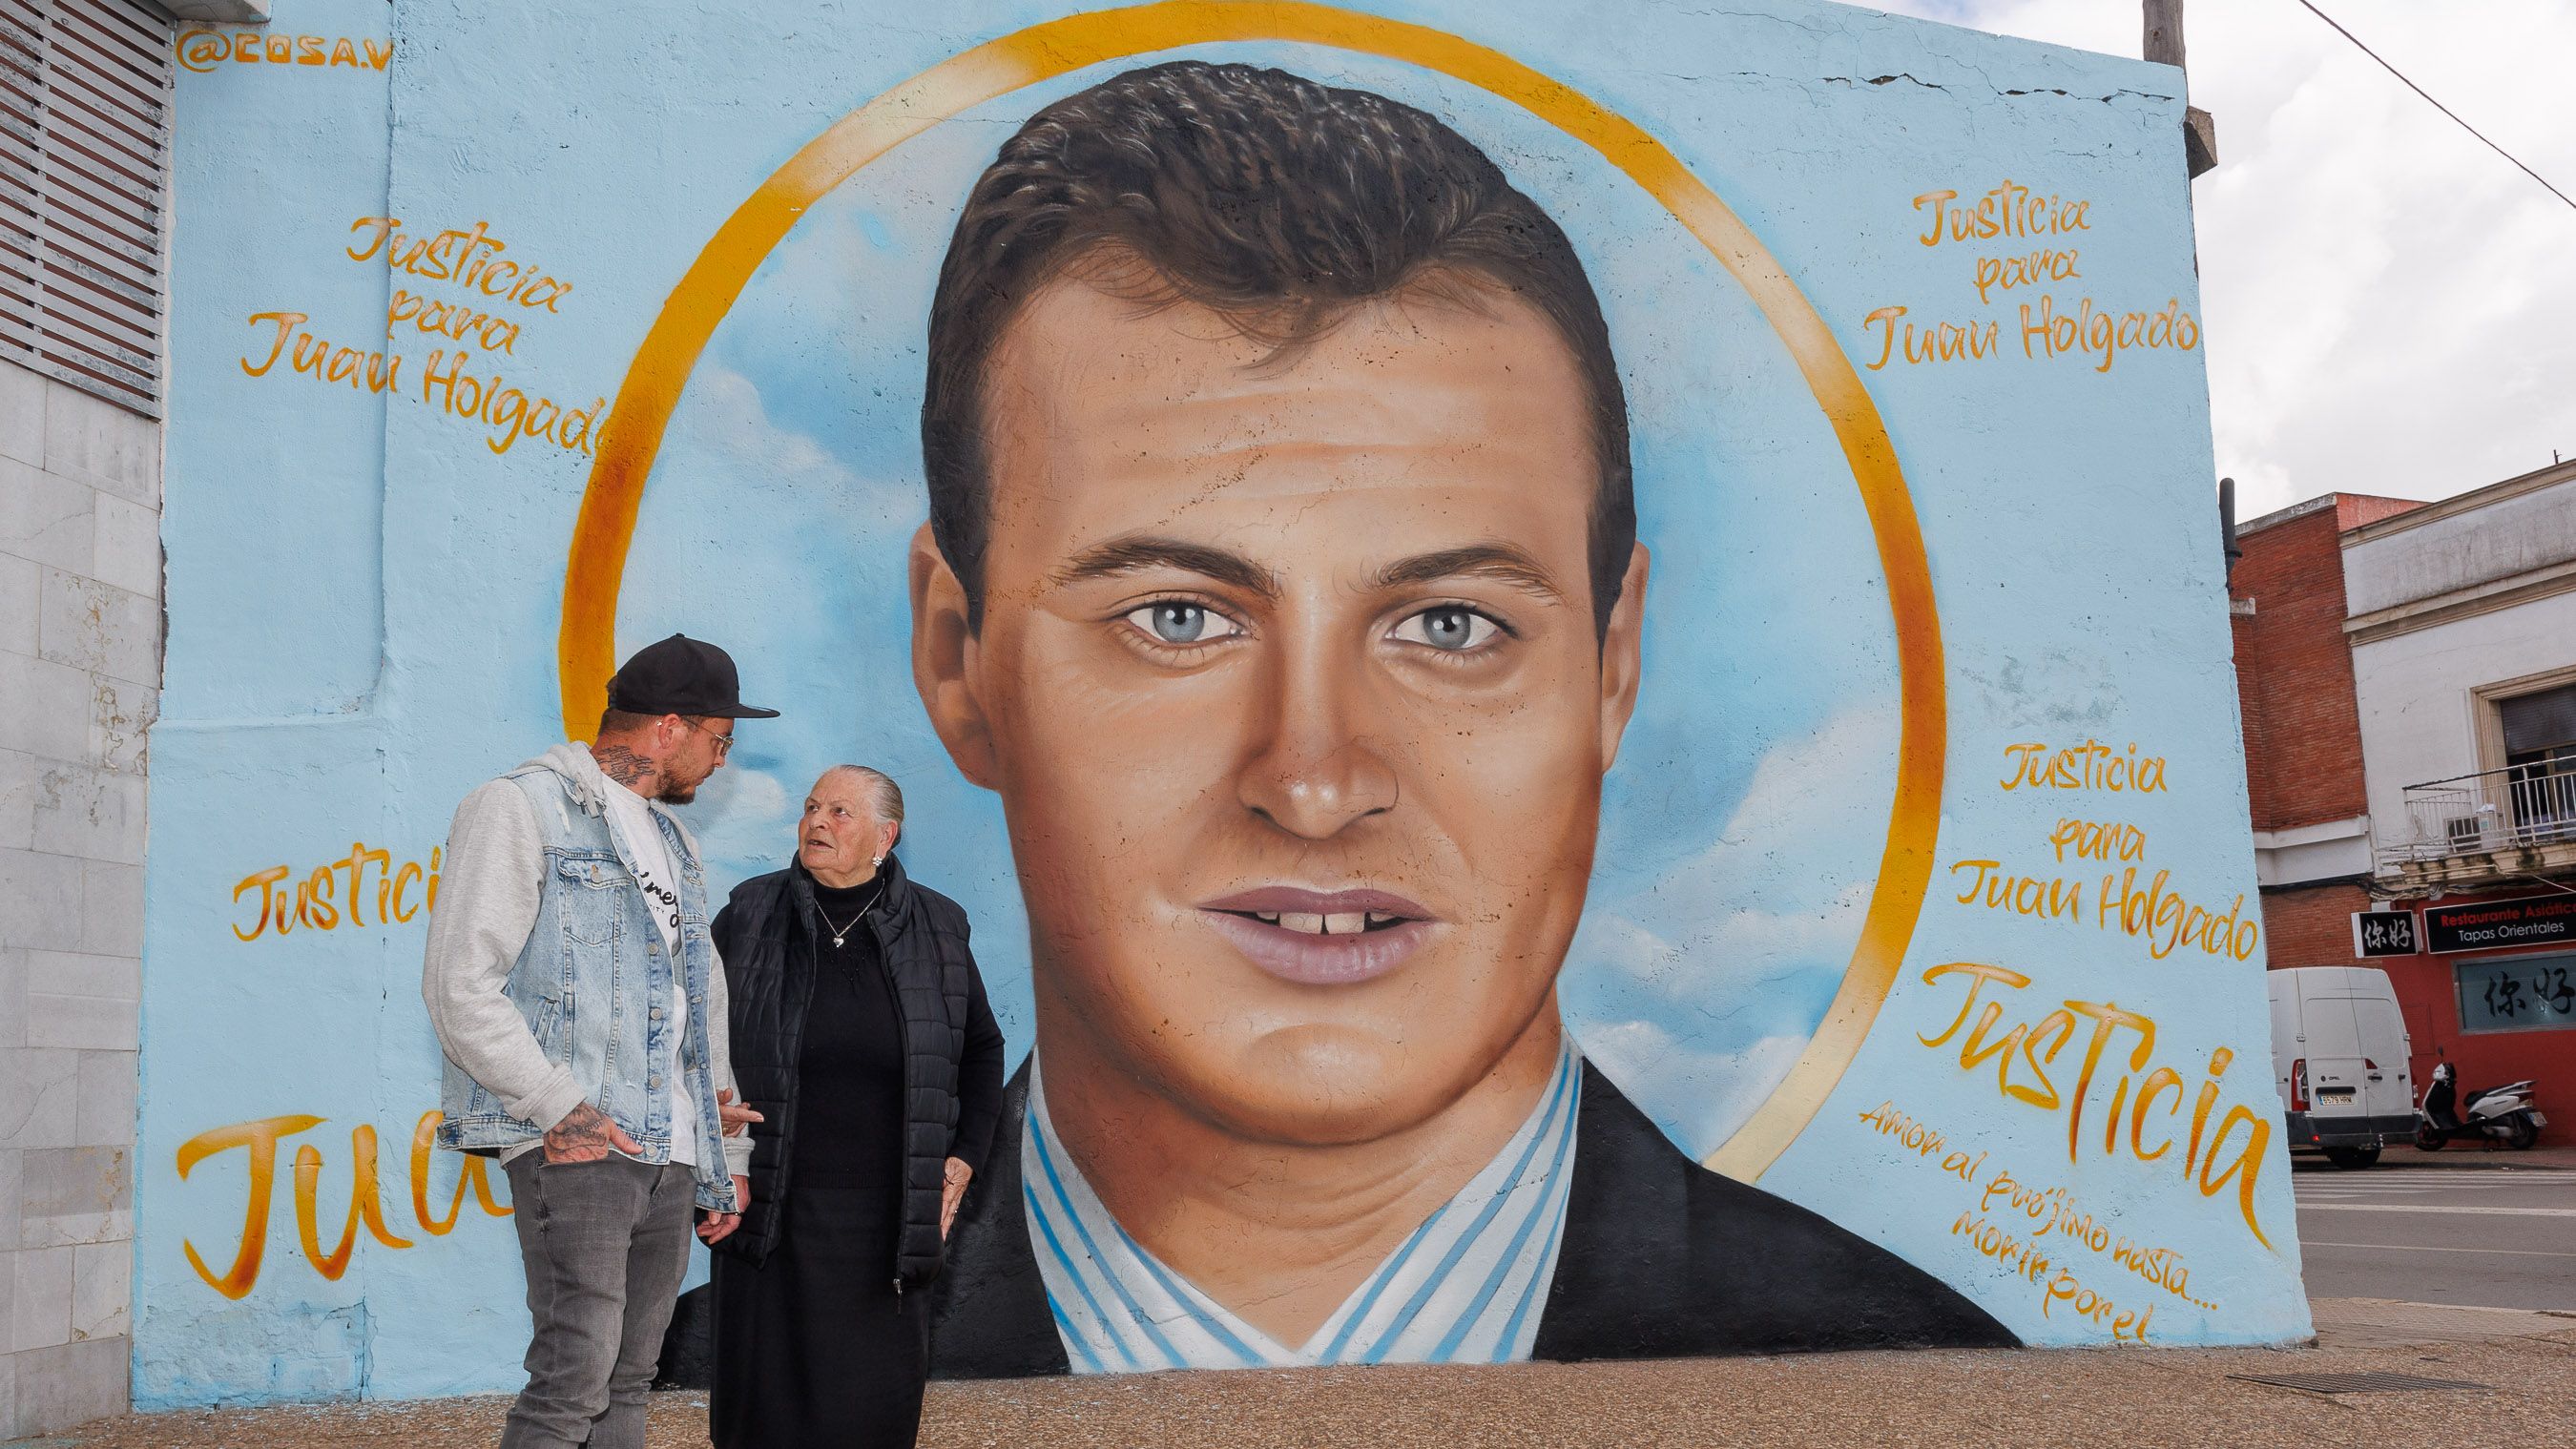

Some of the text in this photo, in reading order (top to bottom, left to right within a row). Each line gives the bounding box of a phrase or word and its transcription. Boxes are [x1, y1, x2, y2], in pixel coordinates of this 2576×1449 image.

[1913, 178, 2091, 247] Justicia
[345, 217, 573, 314] Justicia
[1973, 248, 2083, 305] para
[387, 289, 520, 355] para
[1863, 295, 2199, 373] Juan Holgado
[240, 311, 399, 395] Juan
[2000, 739, 2169, 794] Justicia
[2049, 818, 2146, 863] para
[232, 842, 443, 942] Justici
[1950, 859, 2259, 962] Juan Holgado
[2440, 908, 2521, 928] Restaurante
[2364, 919, 2412, 948] 你好
[2458, 921, 2566, 943] Tapas Orientales
[2483, 966, 2576, 1018] 你好
[1942, 1150, 1988, 1183] al
[176, 1110, 515, 1301] Jua
